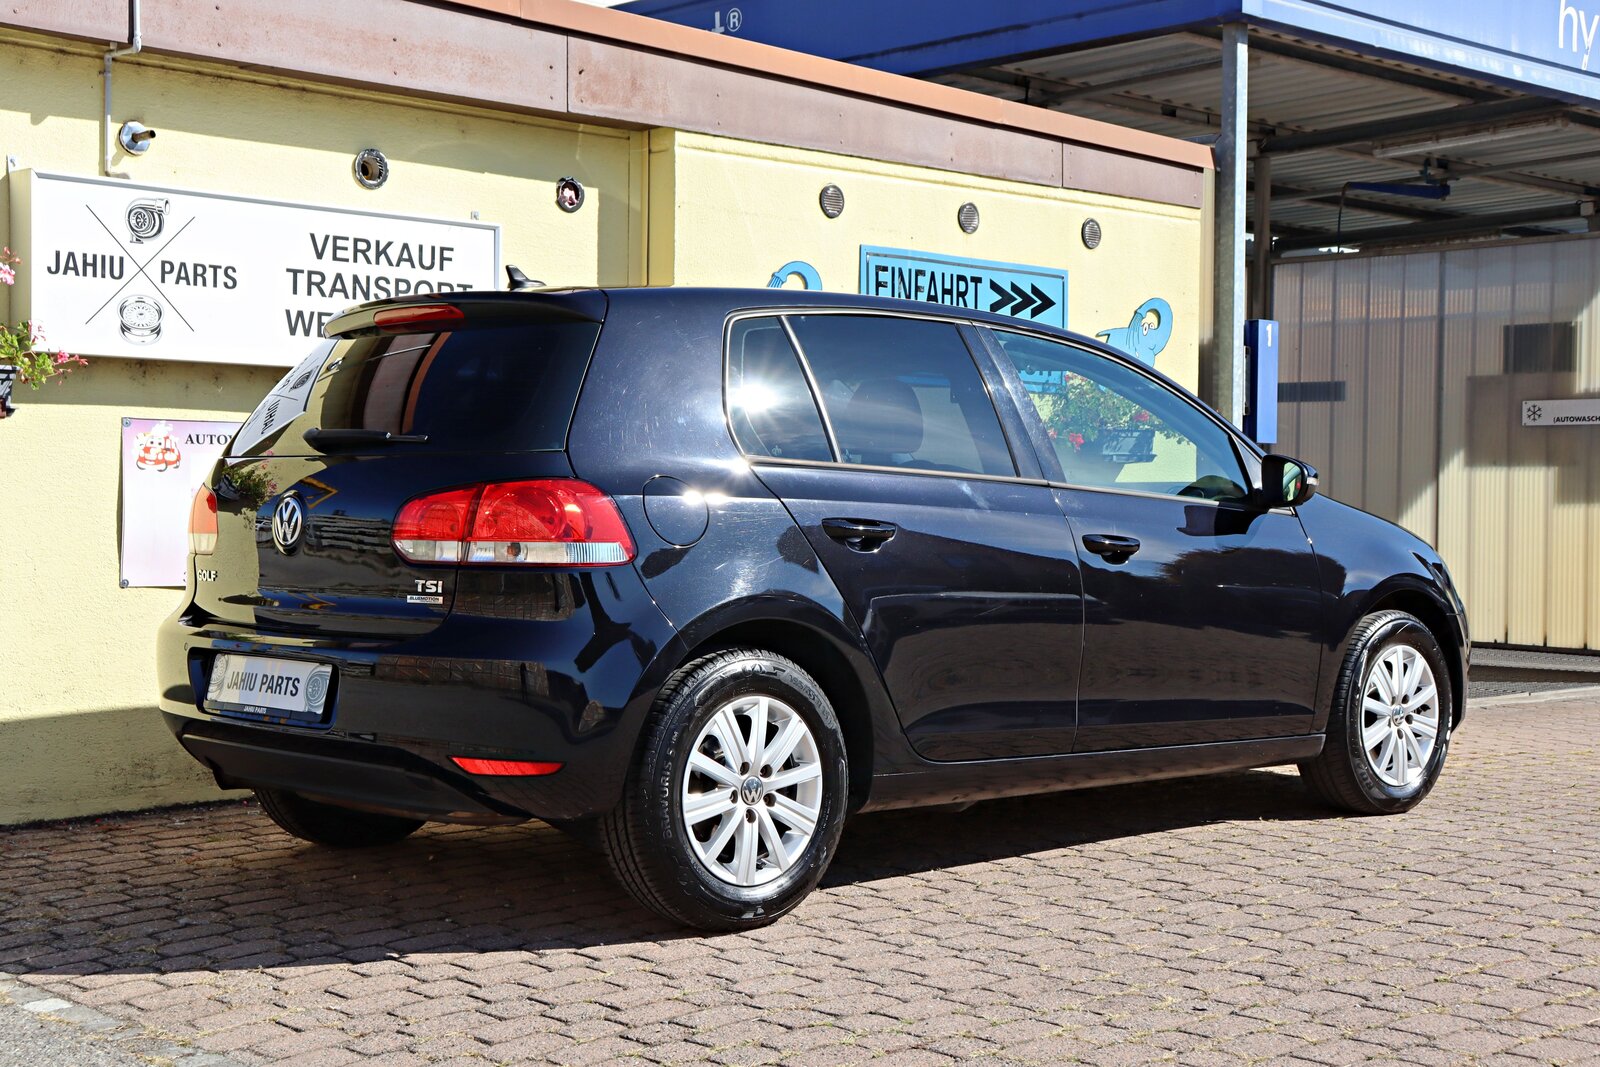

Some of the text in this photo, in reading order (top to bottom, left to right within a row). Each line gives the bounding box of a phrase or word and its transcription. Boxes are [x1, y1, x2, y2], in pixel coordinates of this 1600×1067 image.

[309, 232, 455, 272] VERKAUF
[46, 250, 238, 290] JAHIU PARTS
[285, 267, 474, 301] TRANSPO
[874, 264, 983, 310] EINFAHRT
[1265, 323, 1273, 348] 1
[184, 433, 233, 446] AUTO
[198, 569, 218, 582] GOLF
[414, 579, 443, 594] TSI
[227, 671, 301, 698] JAHIU PARTS
